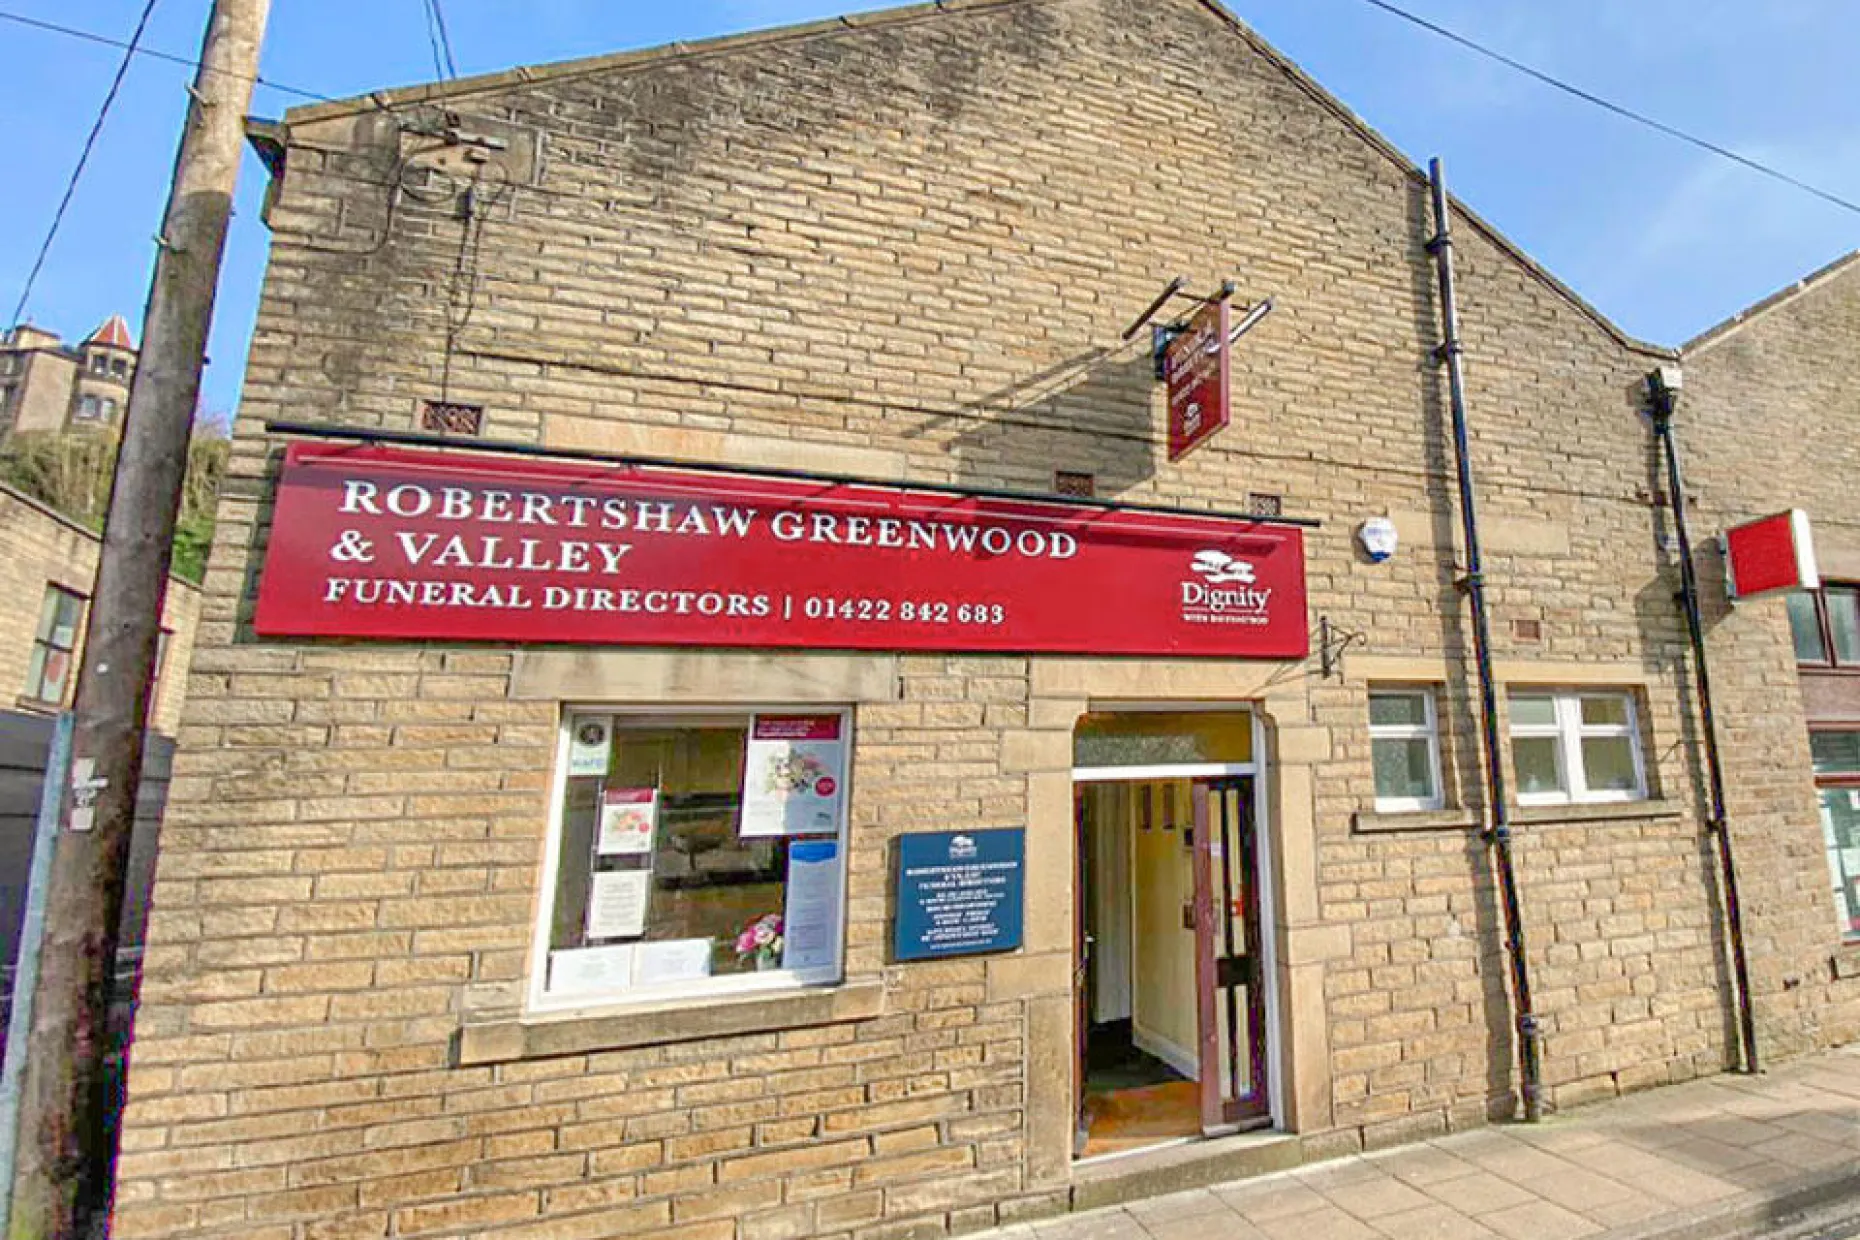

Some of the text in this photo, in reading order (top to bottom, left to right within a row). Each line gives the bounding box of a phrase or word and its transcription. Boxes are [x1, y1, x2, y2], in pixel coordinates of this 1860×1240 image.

[337, 479, 1078, 559] ROBERTSHAW GREENWOOD
[330, 529, 634, 574] & VALLEY
[323, 577, 532, 608] FUNERAL
[542, 586, 770, 616] DIRECTORS
[804, 597, 891, 621] 01422
[899, 601, 950, 623] 842
[956, 603, 1005, 625] 683
[1180, 581, 1268, 614] Dignity
